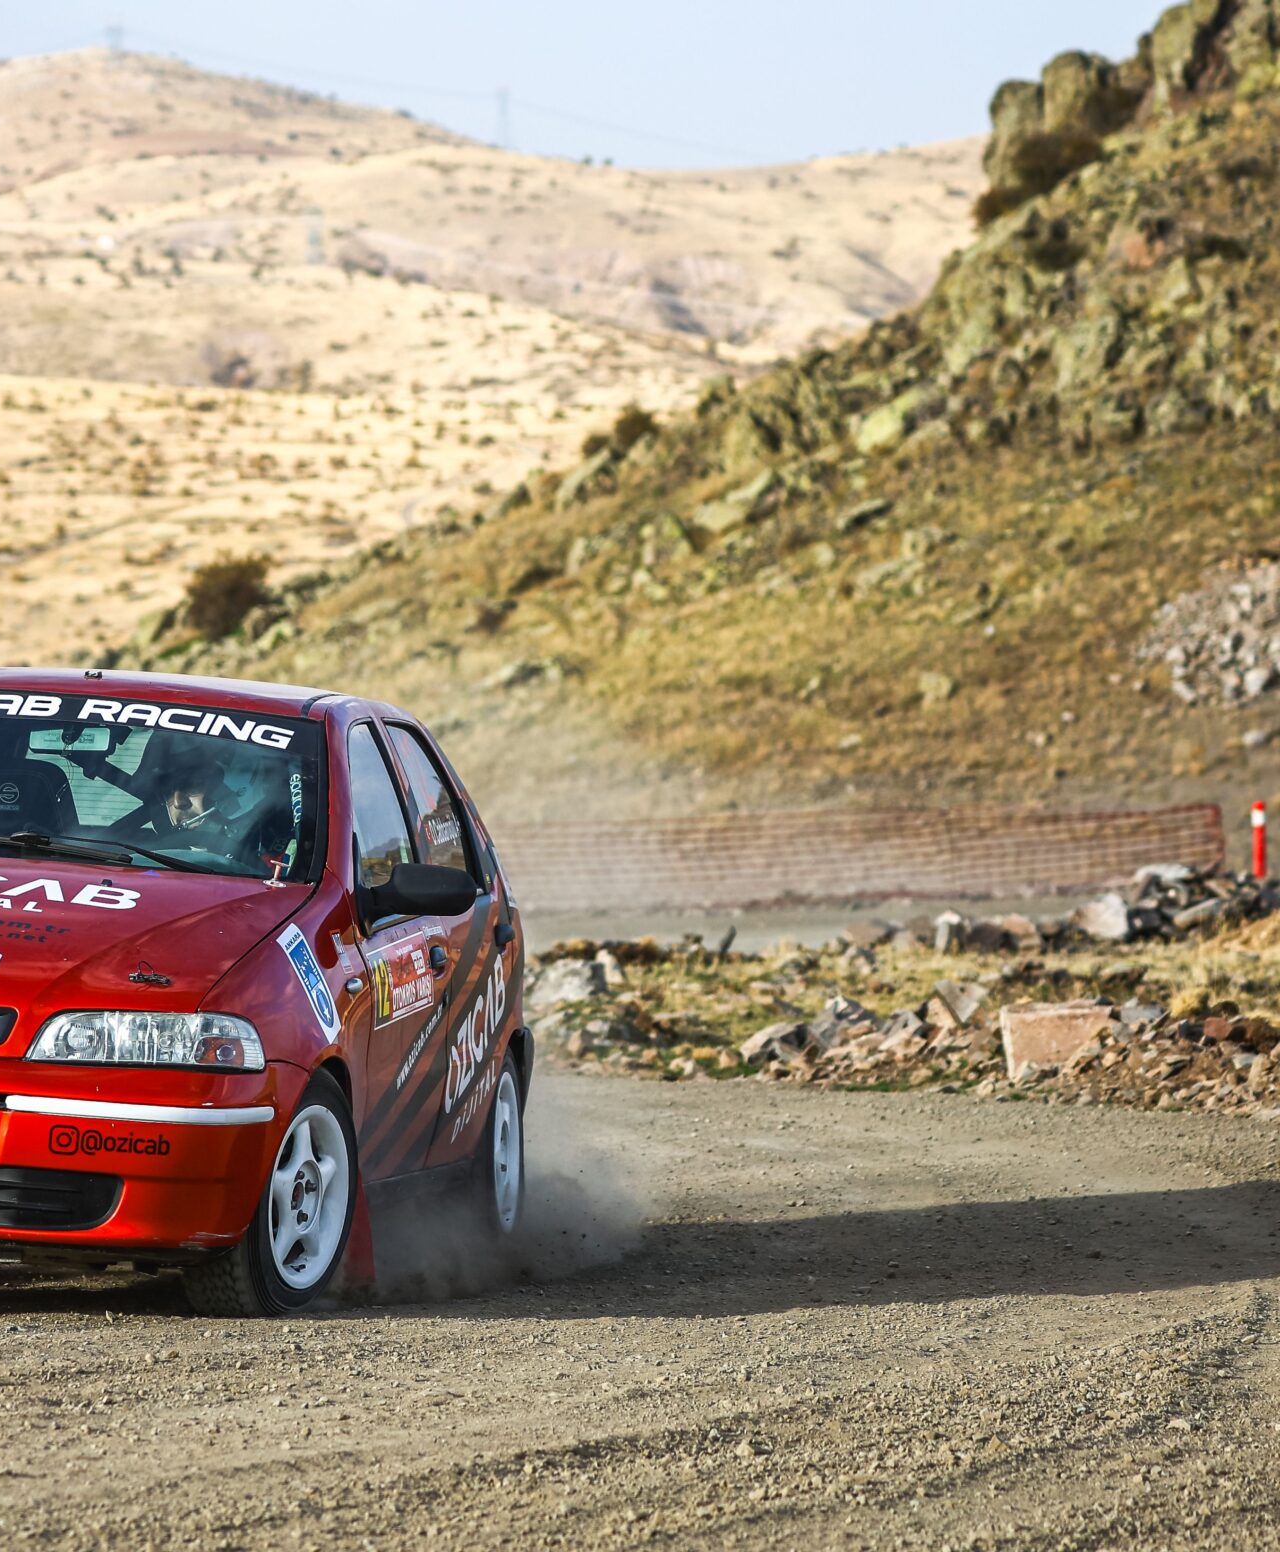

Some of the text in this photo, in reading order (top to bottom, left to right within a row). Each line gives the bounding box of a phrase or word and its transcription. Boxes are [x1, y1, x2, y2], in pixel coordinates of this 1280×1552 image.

[77, 698, 296, 750] RACING
[284, 931, 302, 951] ANKARA
[373, 958, 390, 1019] 12
[444, 953, 506, 1114] OZICAB
[81, 1129, 171, 1156] @ozicab
